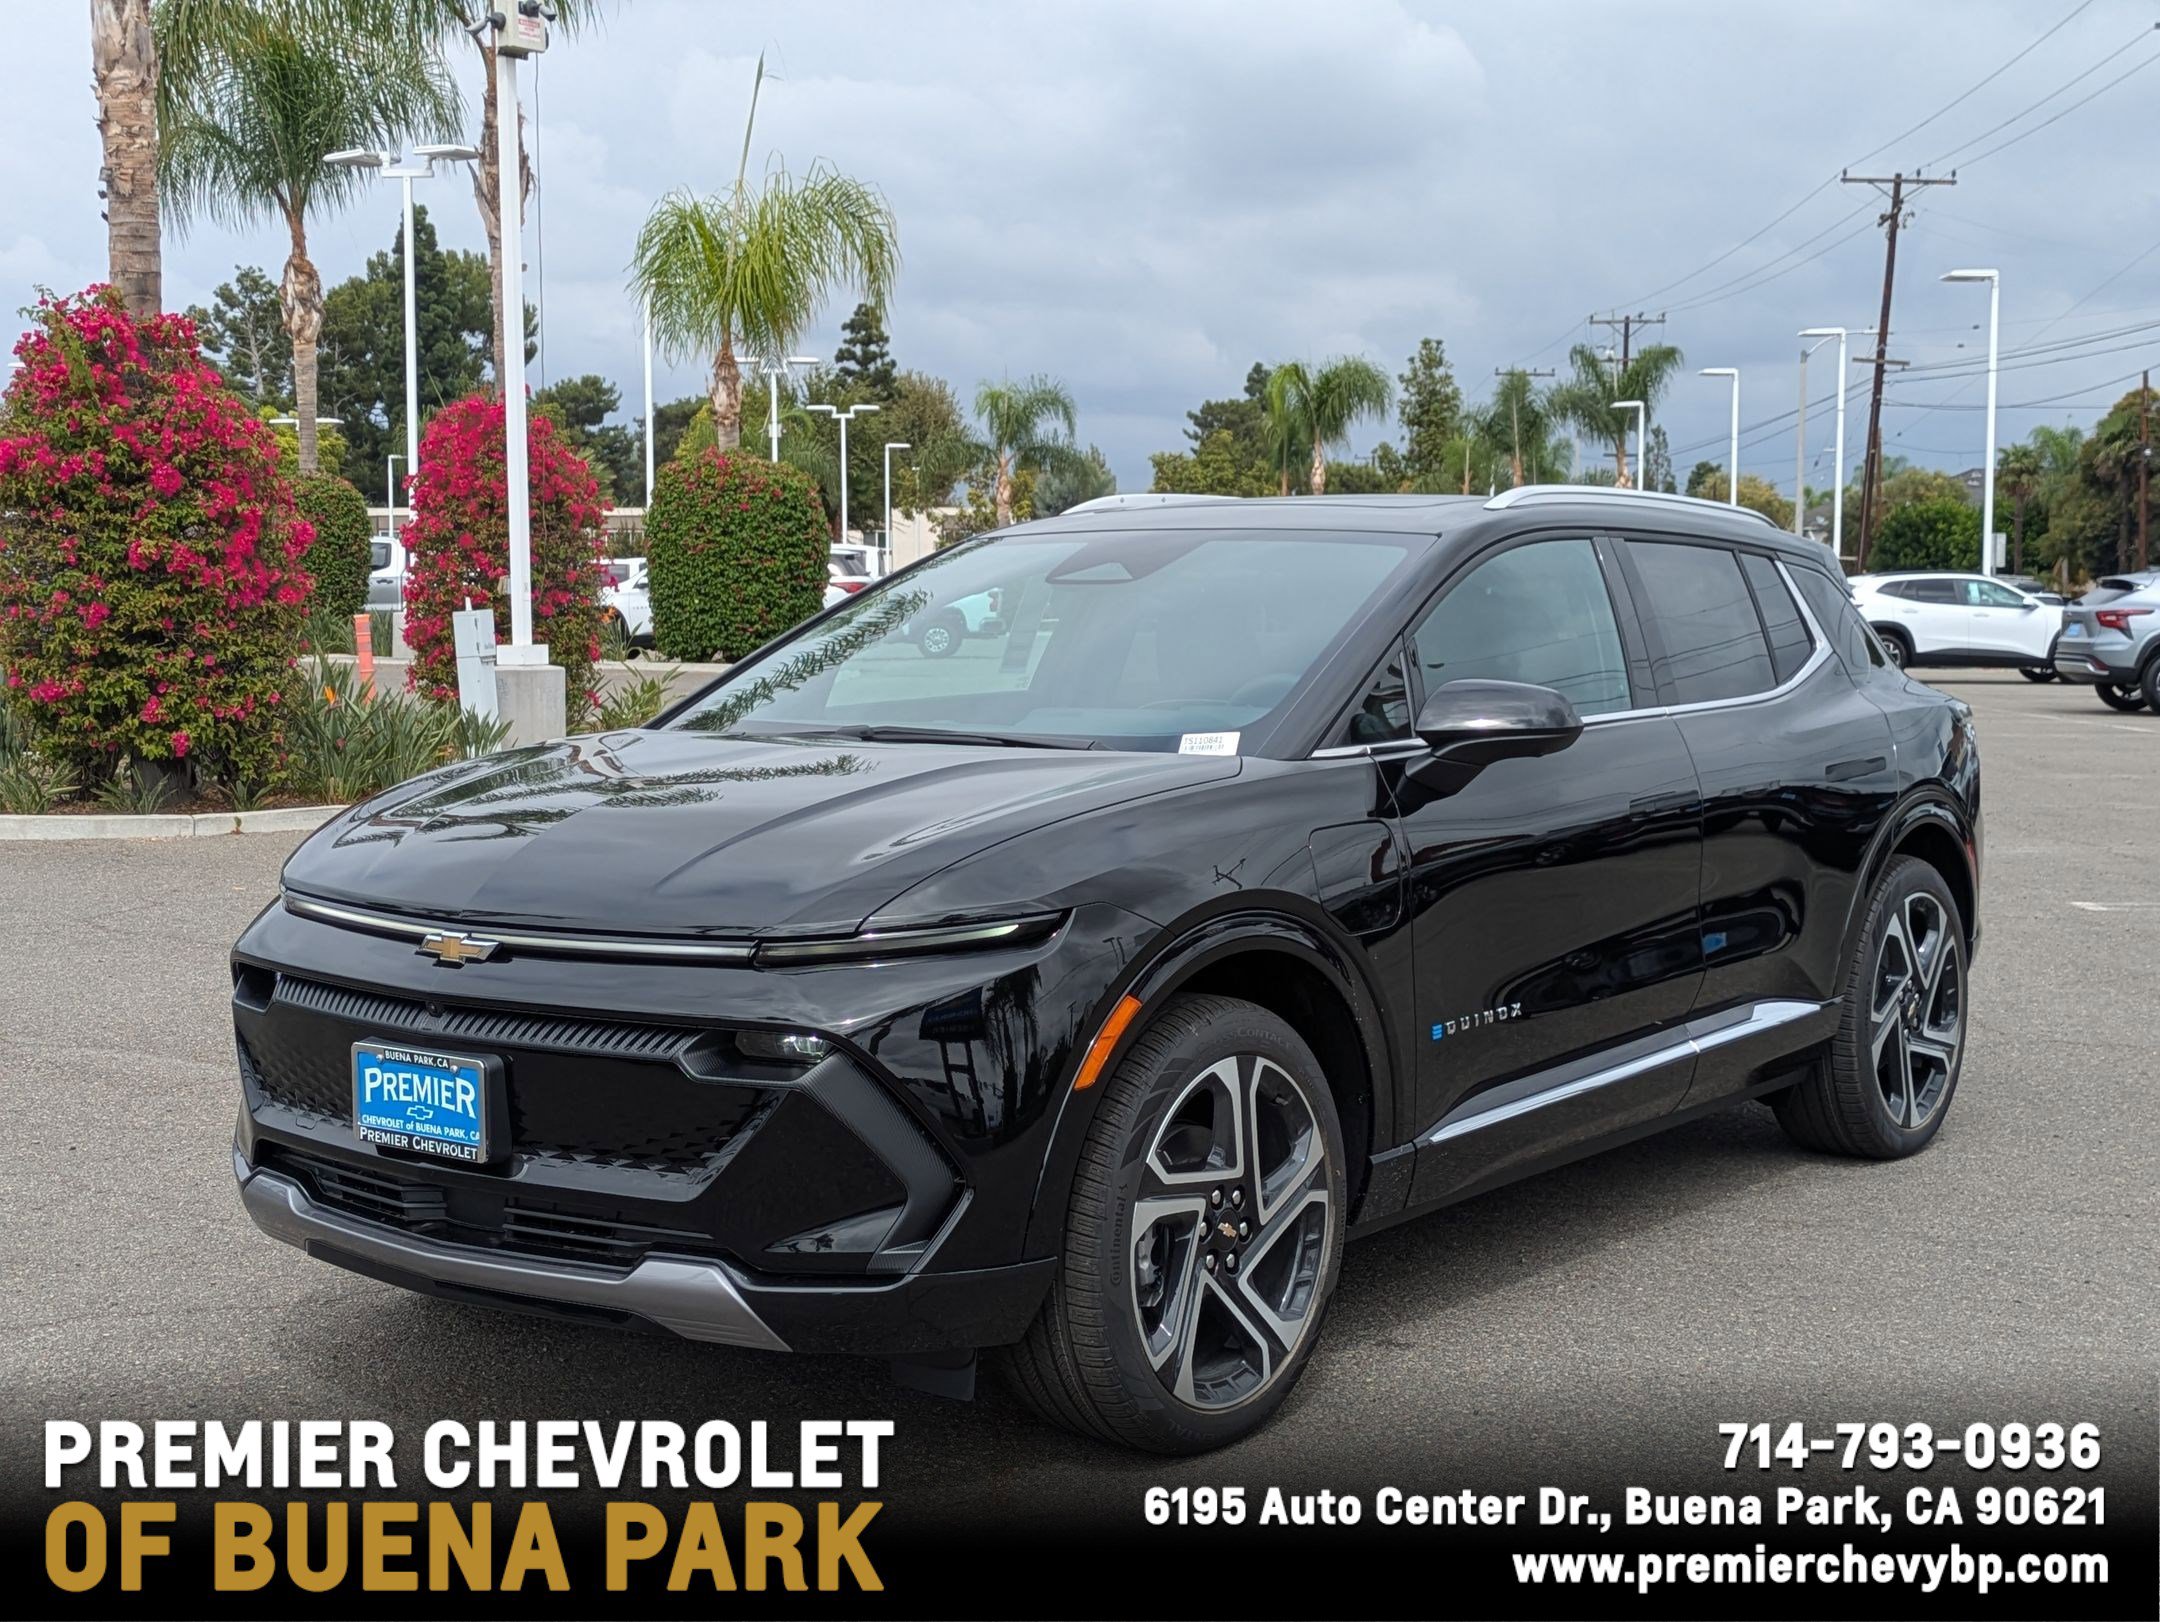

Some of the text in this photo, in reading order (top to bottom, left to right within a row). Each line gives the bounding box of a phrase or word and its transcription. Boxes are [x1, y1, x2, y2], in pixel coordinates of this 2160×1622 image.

[1432, 1002, 1522, 1040] EQUINOX
[385, 1050, 412, 1063] BUENA
[364, 1067, 477, 1120] PREMIER
[360, 1127, 478, 1160] PREMIER CHEVROLET
[362, 1115, 480, 1141] CHEVROLET of BUENA PARK, CA
